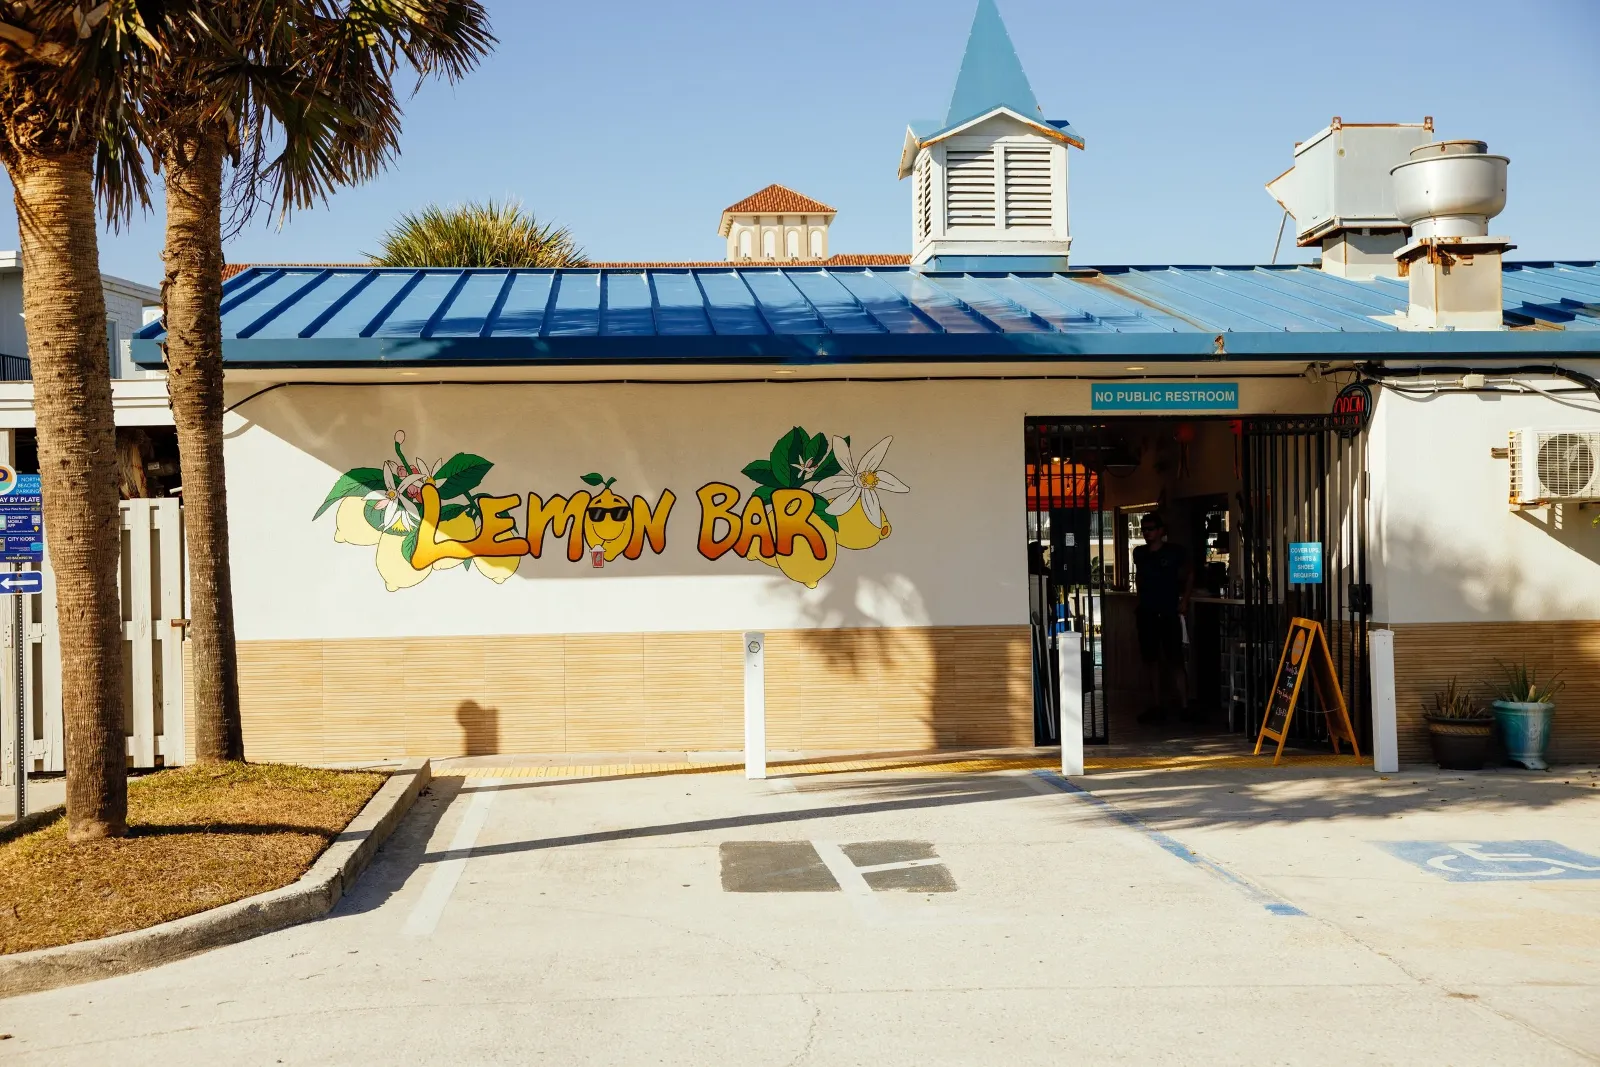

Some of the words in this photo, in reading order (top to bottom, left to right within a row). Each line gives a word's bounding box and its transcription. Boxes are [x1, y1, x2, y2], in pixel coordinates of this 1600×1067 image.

[1095, 391, 1113, 402] NO
[1116, 391, 1162, 402] PUBLIC
[1165, 391, 1235, 401] RESTROOM
[410, 480, 677, 570] LEMON
[695, 481, 828, 560] BAR
